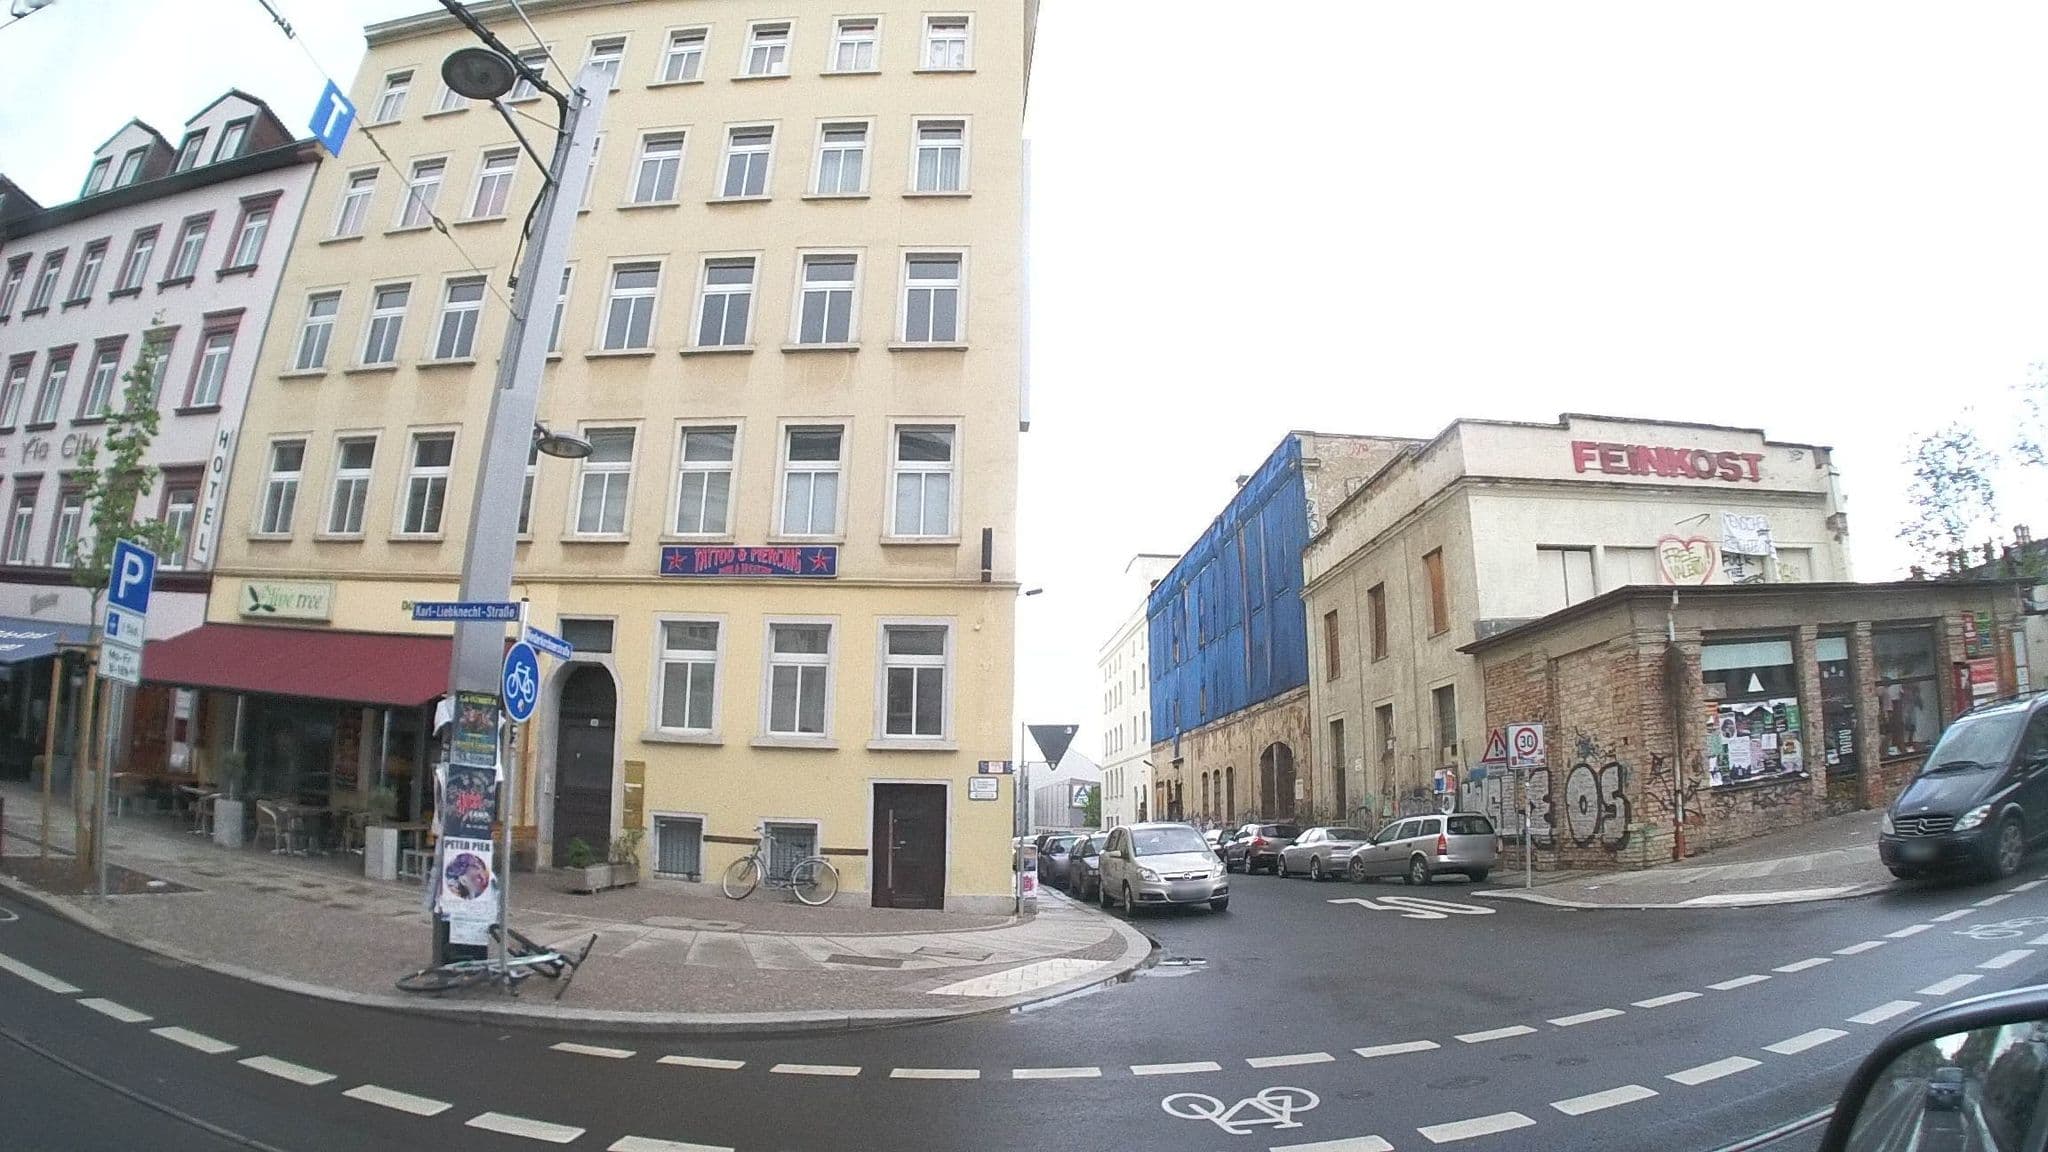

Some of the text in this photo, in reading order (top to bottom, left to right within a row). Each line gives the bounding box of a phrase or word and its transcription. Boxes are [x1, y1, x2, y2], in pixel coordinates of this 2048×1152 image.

[1571, 440, 1763, 482] FEINKOST
[199, 429, 229, 551] HOTEL
[118, 551, 144, 598] P
[415, 604, 515, 619] Karl-Liebknecht-Straße
[1520, 735, 1534, 748] 30
[444, 839, 470, 851] PETER
